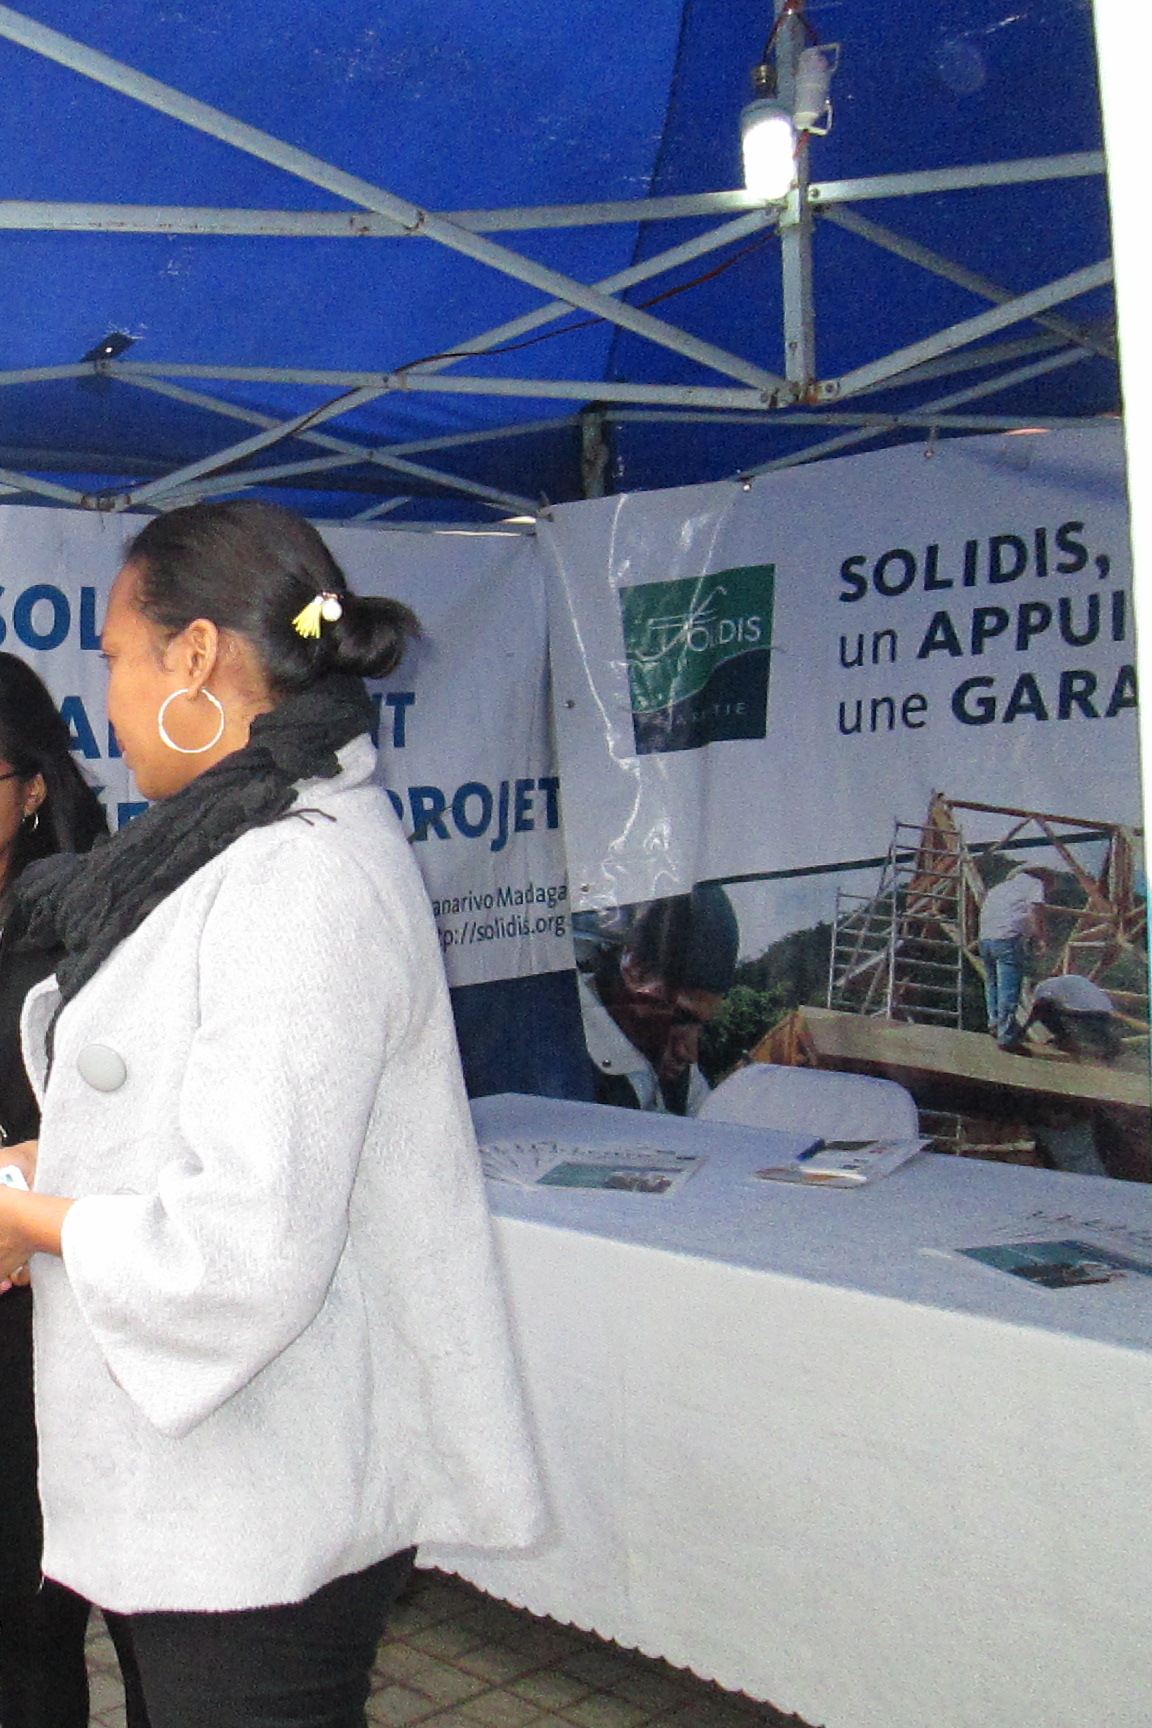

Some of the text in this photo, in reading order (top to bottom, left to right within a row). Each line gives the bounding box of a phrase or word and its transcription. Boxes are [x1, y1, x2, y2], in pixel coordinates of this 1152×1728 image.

[839, 521, 1111, 602] SOLIDIS,
[839, 590, 1126, 669] un APPUI
[839, 692, 928, 735] une
